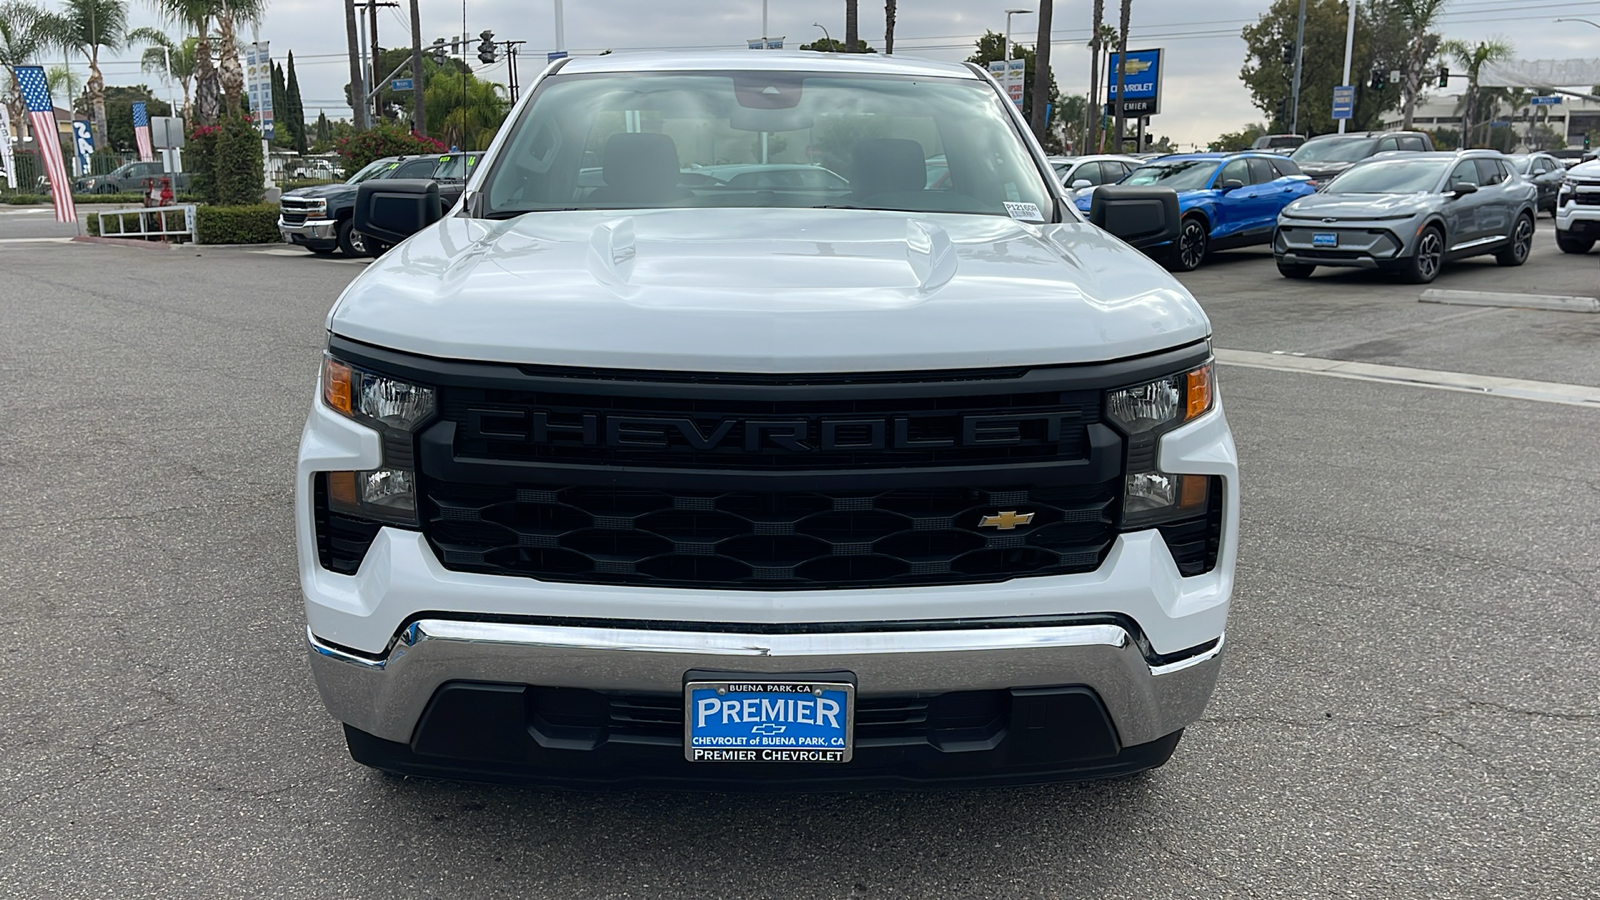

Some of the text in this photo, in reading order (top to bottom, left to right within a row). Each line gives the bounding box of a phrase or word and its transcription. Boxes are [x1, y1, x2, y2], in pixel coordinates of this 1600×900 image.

[1110, 83, 1153, 93] CVROLET
[466, 407, 1083, 452] CHEVROLET
[698, 698, 840, 728] PREMIER
[693, 737, 747, 745] CHEVROLET
[750, 736, 760, 745] of
[763, 737, 794, 745] BUENA
[799, 737, 828, 746] PARK,
[694, 750, 843, 761] PREMIER CHEVROLET
